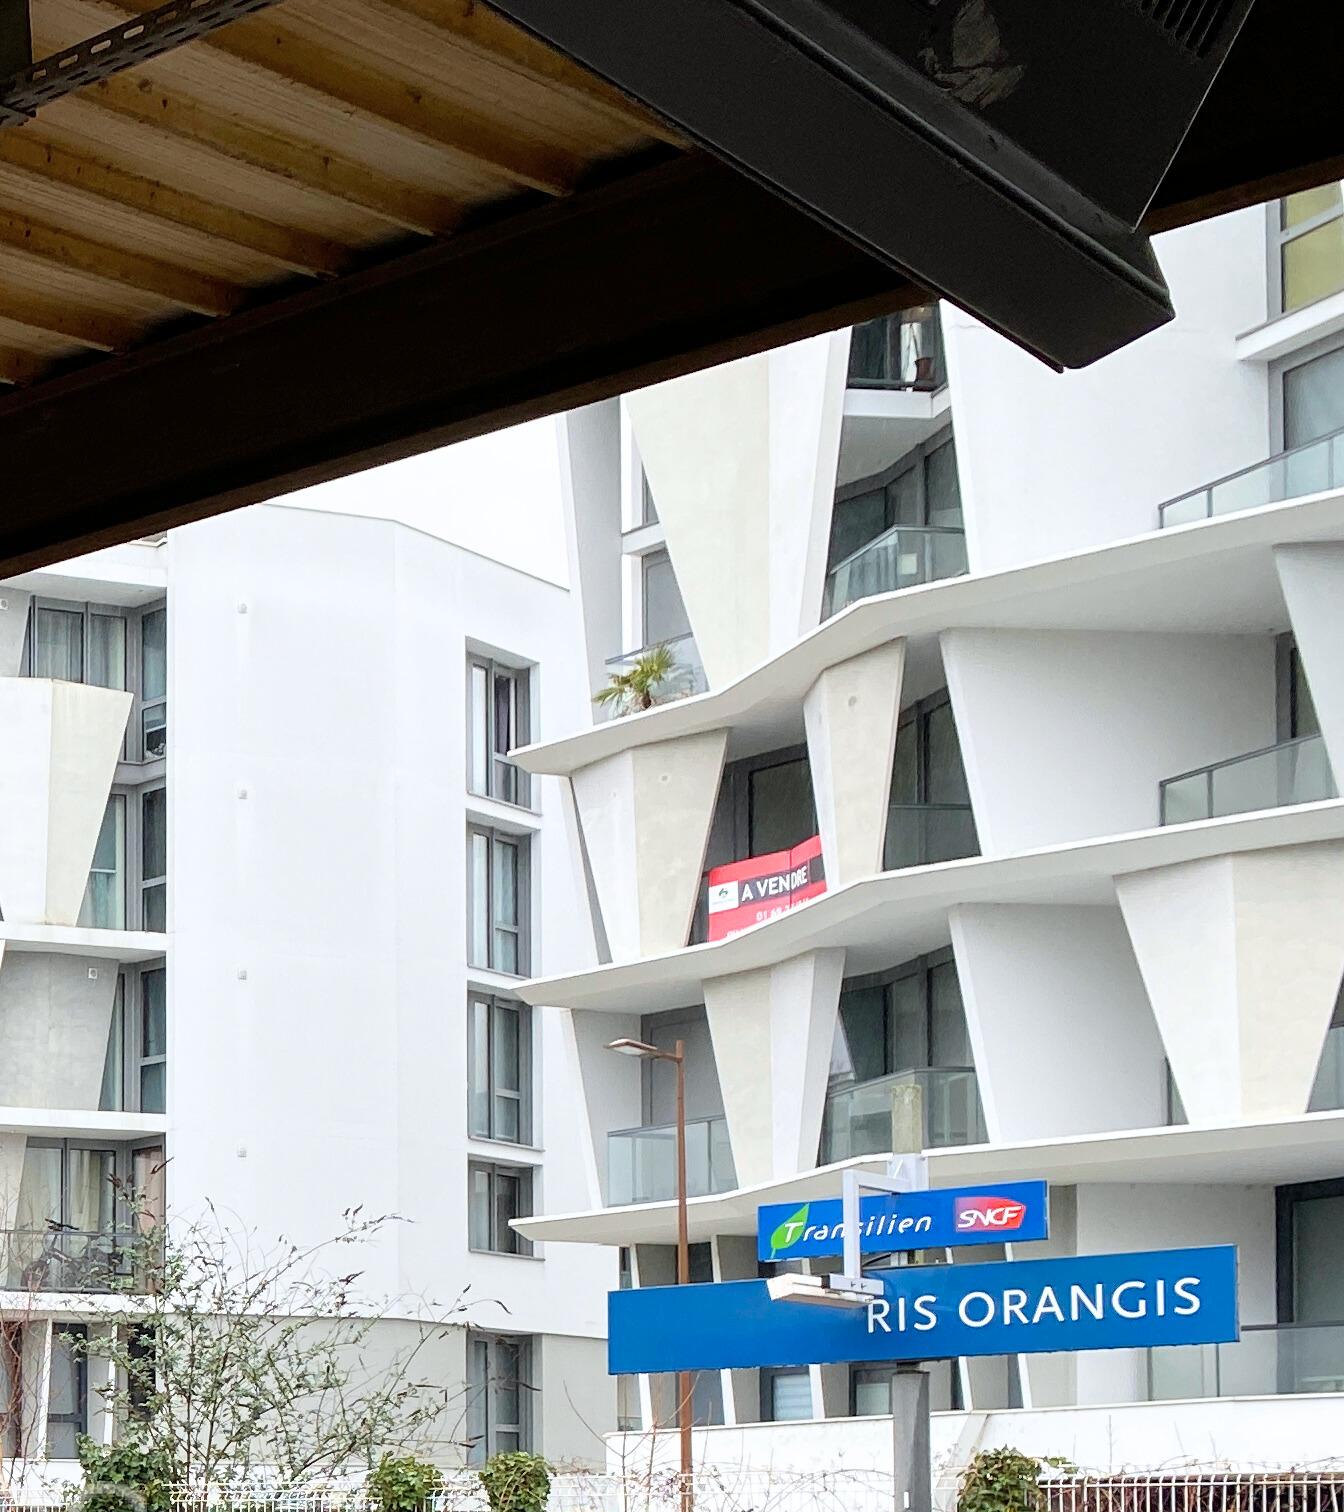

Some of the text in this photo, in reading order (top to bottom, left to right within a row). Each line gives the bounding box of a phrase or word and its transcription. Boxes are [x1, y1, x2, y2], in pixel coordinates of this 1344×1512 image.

[742, 865, 808, 902] A VENDRE
[957, 1206, 1023, 1229] SNCF
[867, 1277, 1202, 1335] RIS ORANGIS
